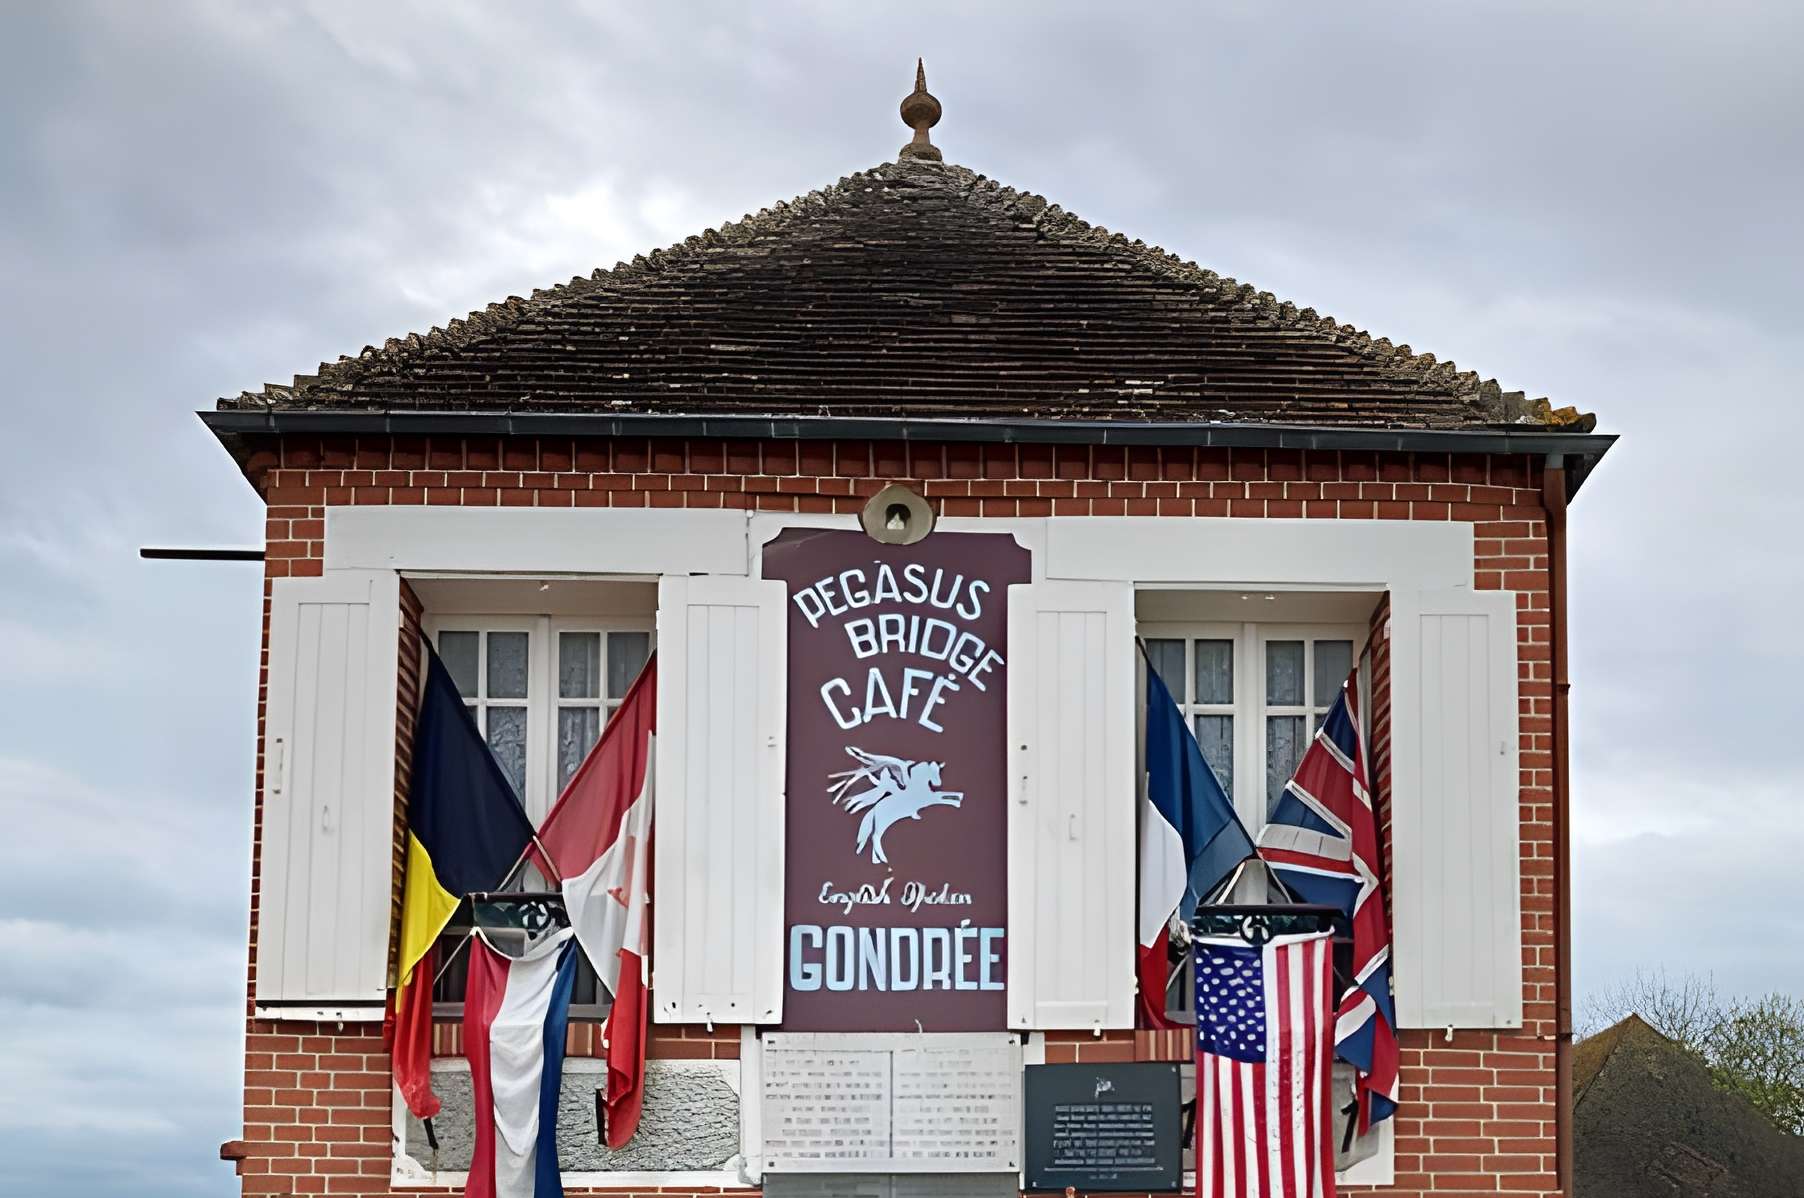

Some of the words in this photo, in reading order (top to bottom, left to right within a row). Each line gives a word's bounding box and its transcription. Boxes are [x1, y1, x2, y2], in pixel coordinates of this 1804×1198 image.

[793, 561, 990, 628] PEGASUS
[844, 613, 1005, 692] BRIDGE
[820, 667, 960, 733] CAFÉ
[790, 919, 1005, 992] GONDRÉE
